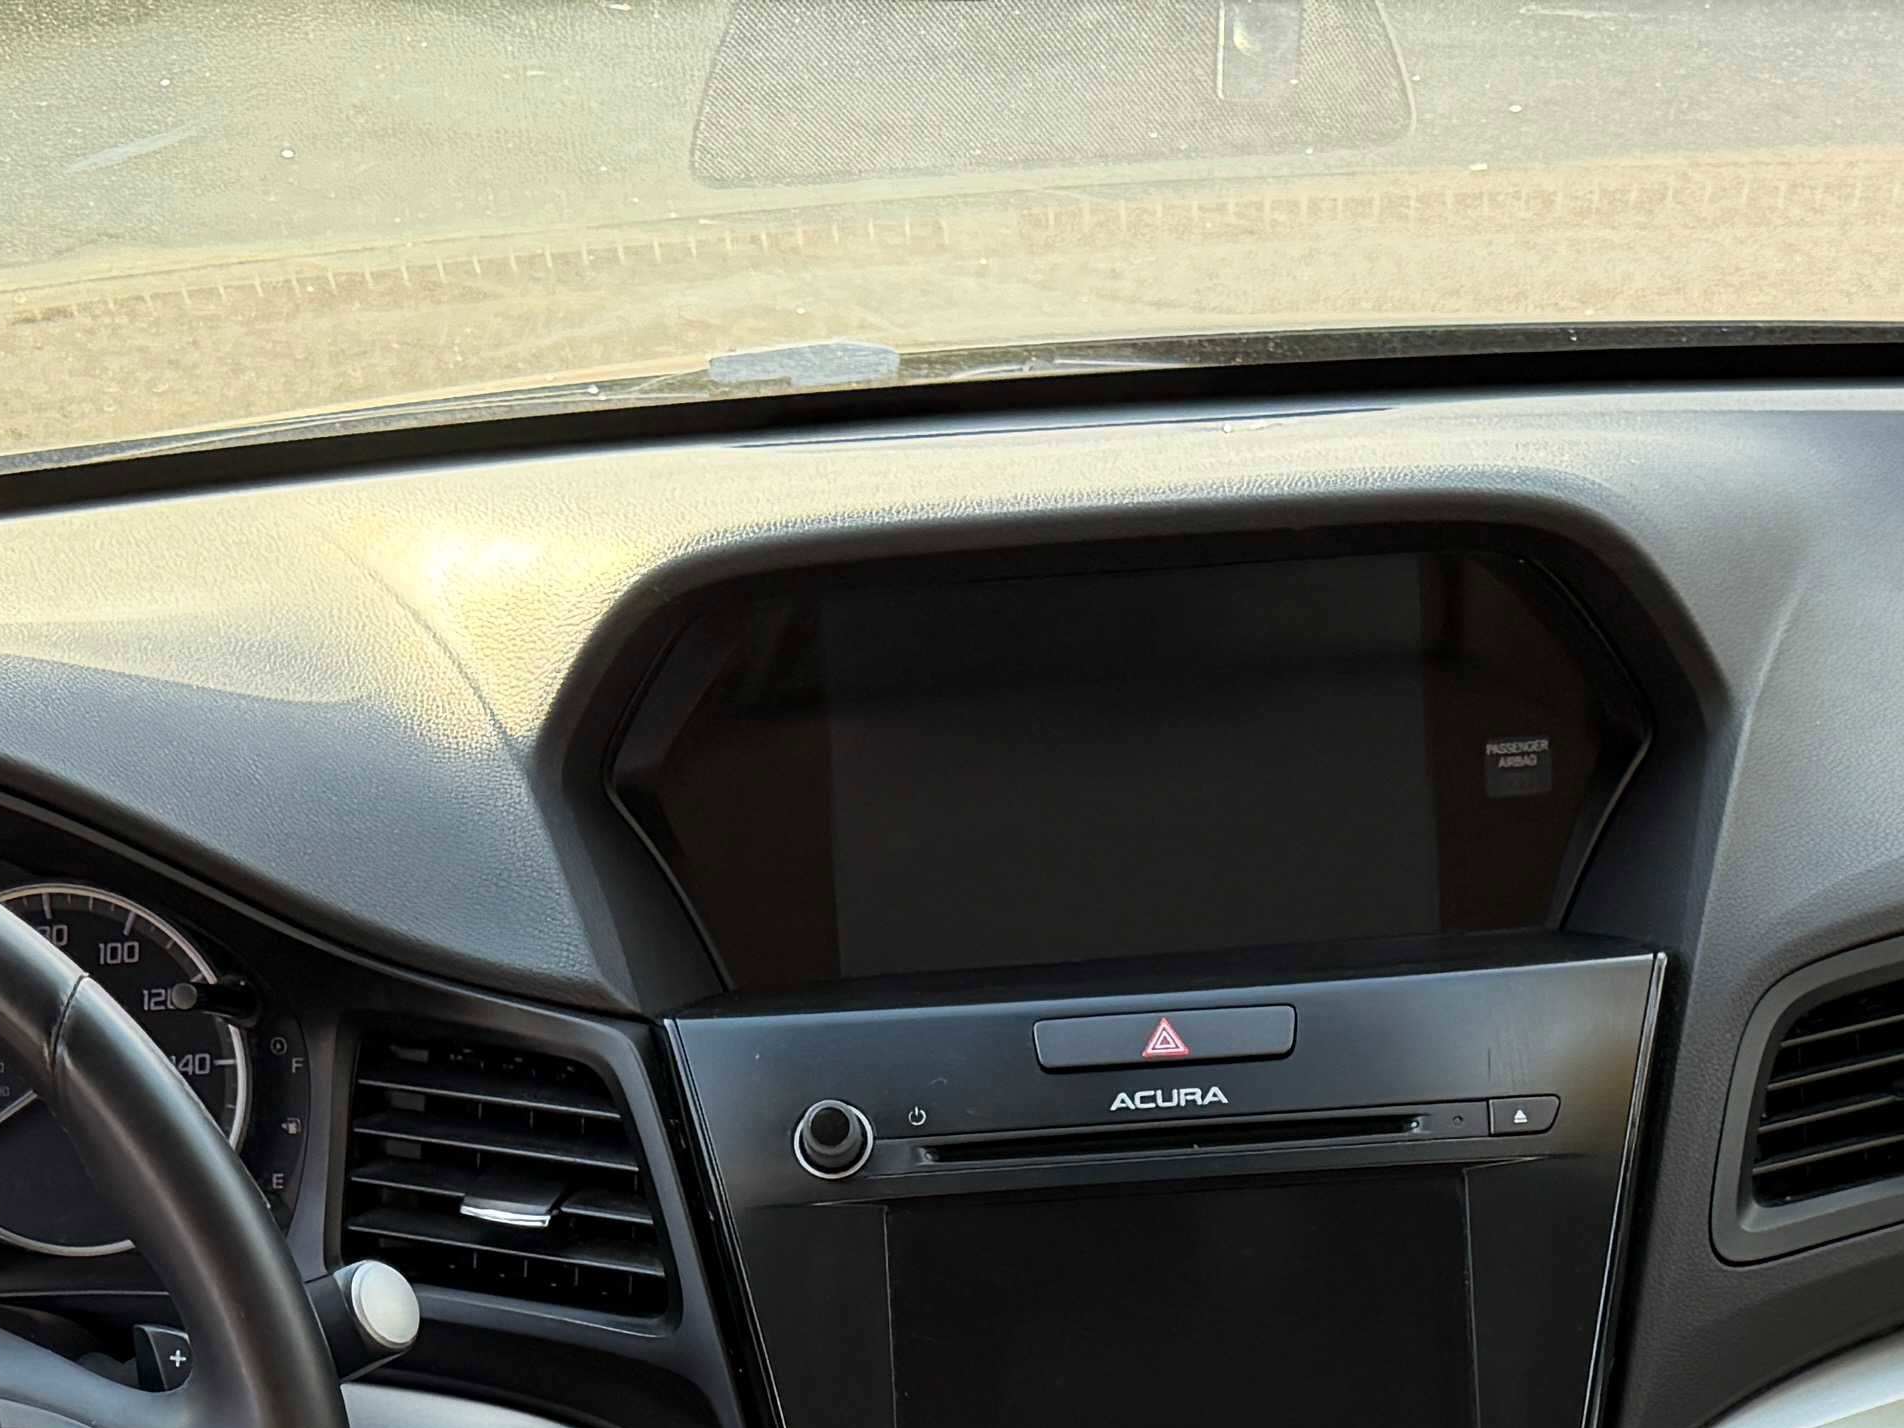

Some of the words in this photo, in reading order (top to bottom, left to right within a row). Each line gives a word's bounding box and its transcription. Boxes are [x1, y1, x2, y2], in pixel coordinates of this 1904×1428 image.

[1485, 740, 1549, 755] PASSENGER
[1498, 753, 1538, 768] AIRBAG
[98, 941, 140, 965] 100
[143, 988, 175, 1011] 12
[291, 1058, 304, 1073] F
[1110, 1085, 1229, 1111] ACURA
[273, 1173, 284, 1189] E
